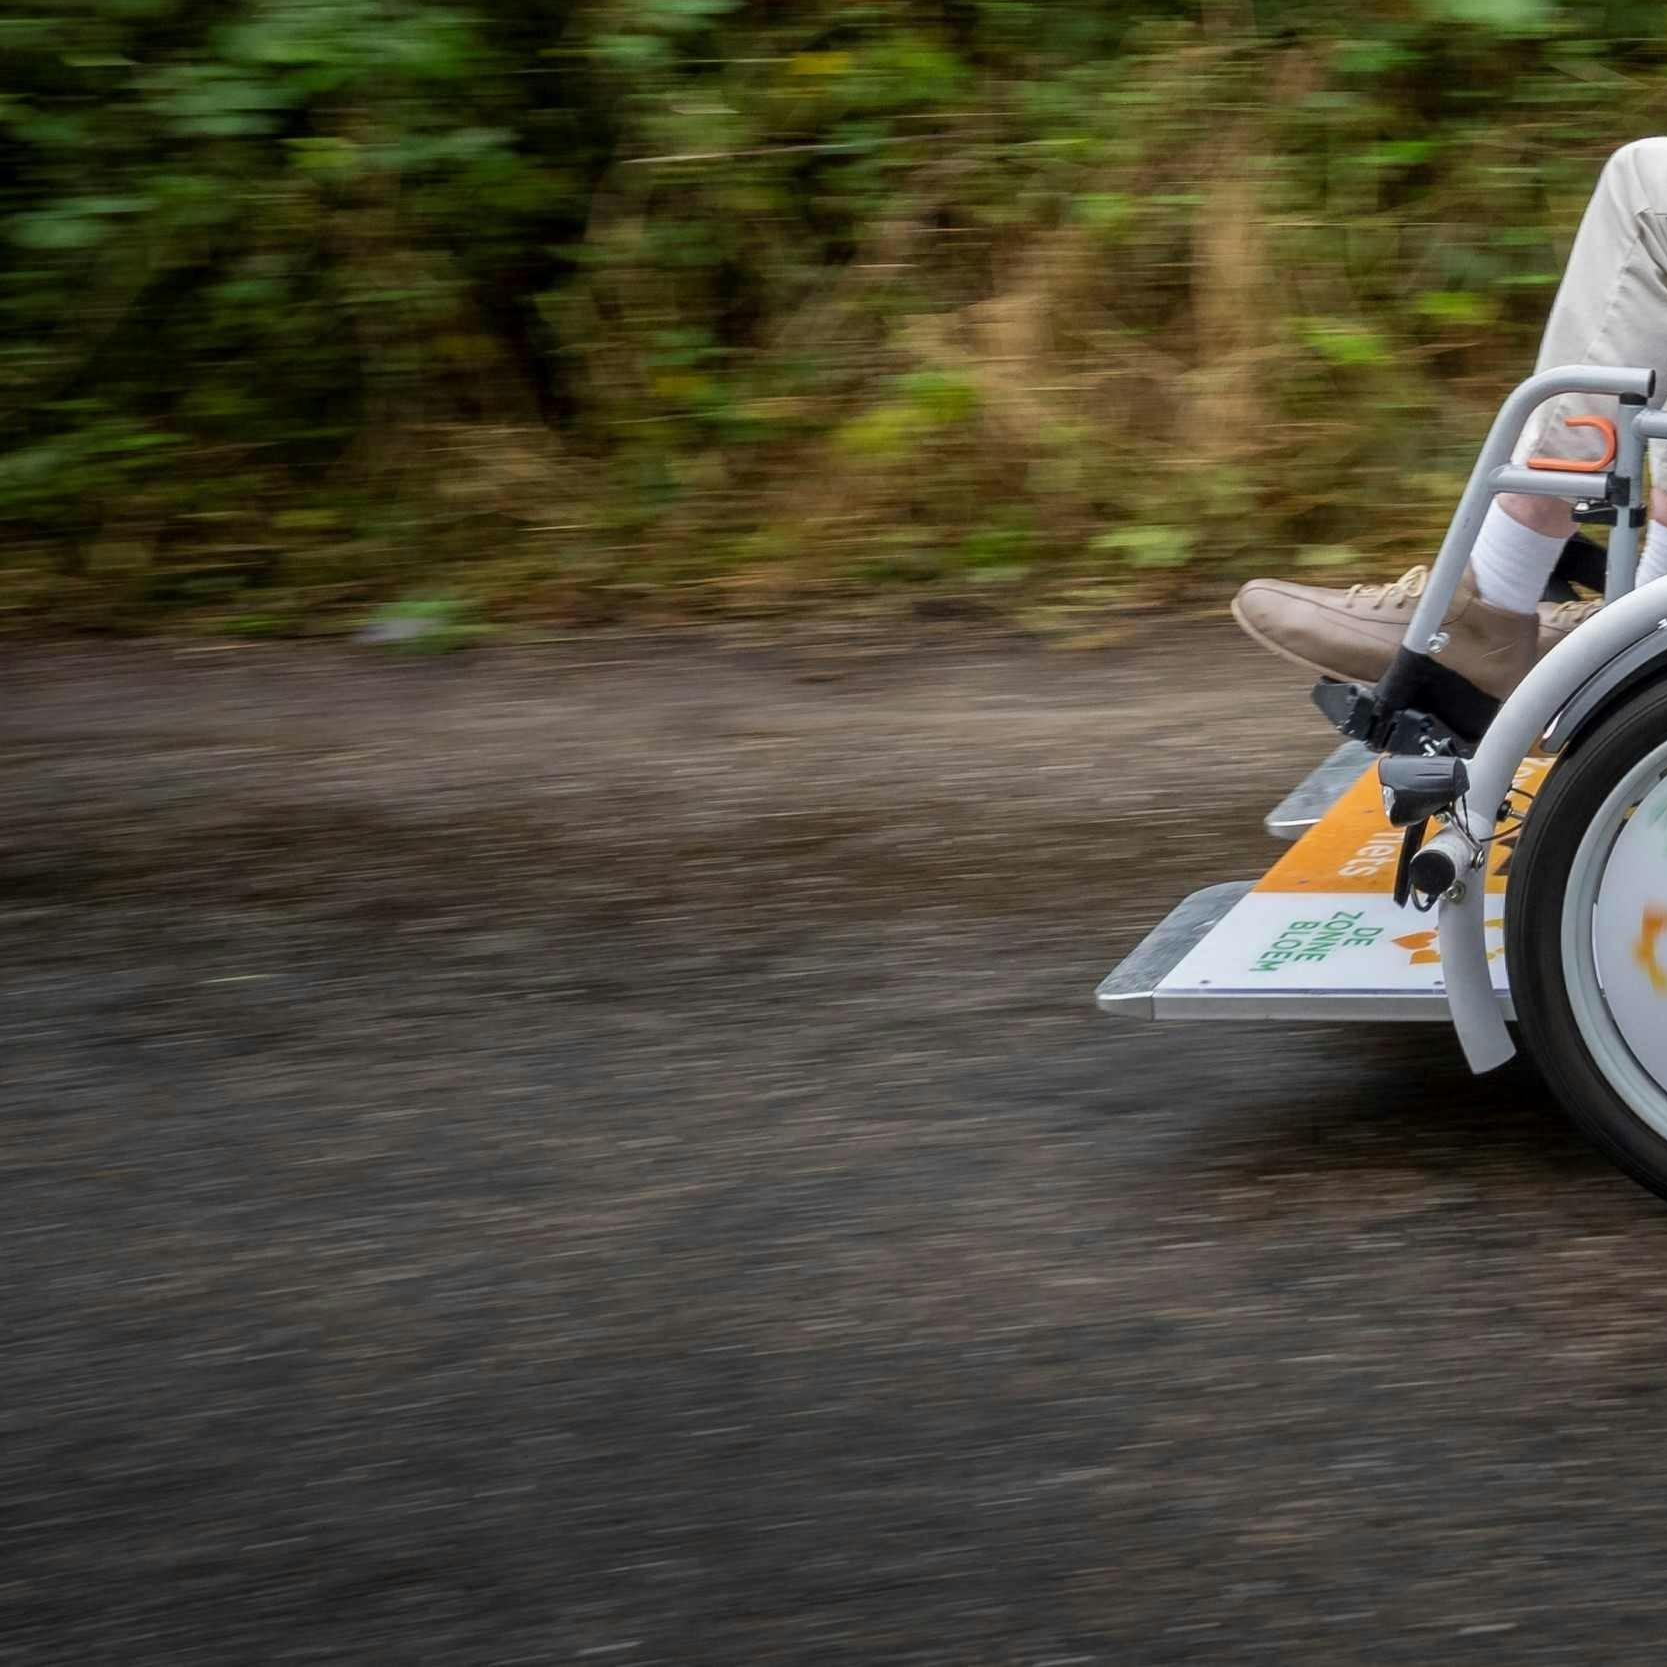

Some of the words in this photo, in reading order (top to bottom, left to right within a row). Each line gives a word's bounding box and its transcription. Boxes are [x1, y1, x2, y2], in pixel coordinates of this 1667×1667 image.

[1249, 920, 1322, 972] BLOEM
[1294, 911, 1365, 962] ZONNE
[1341, 927, 1384, 946] DE
